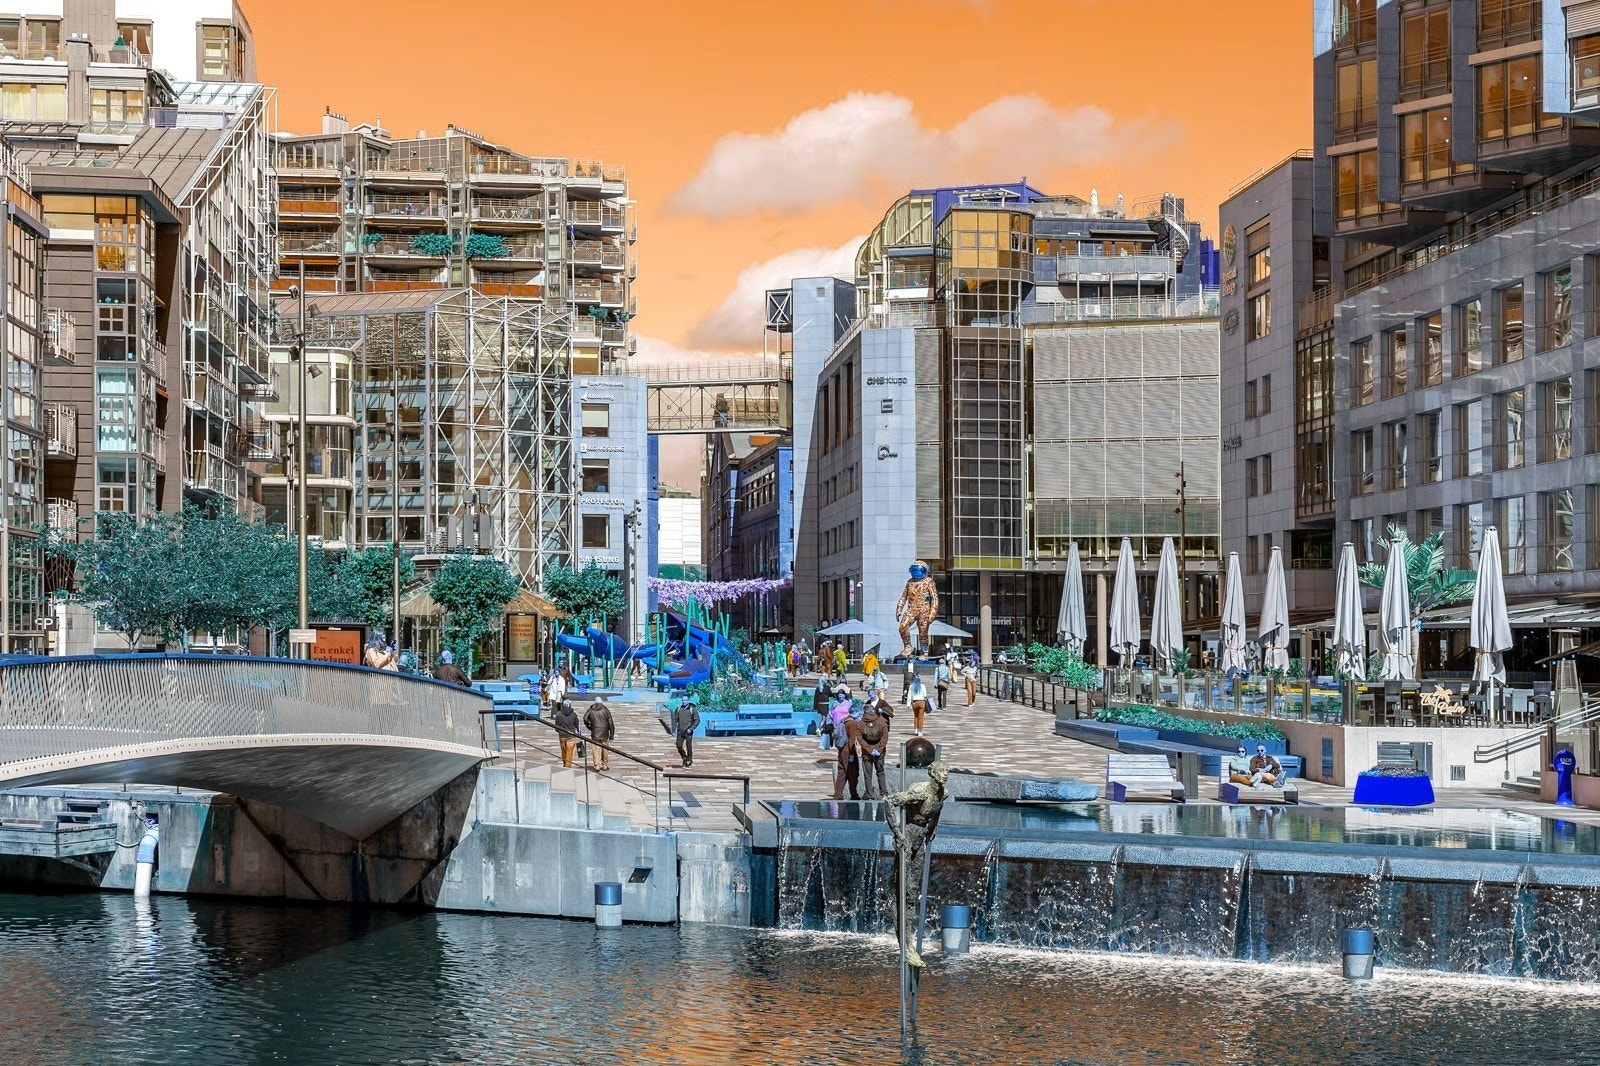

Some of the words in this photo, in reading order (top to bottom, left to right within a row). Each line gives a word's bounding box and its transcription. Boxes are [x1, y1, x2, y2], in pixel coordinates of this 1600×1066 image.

[580, 497, 625, 506] PROTECTOR
[313, 646, 326, 654] En
[328, 646, 354, 654] enkel
[1420, 692, 1437, 706] The
[1438, 701, 1467, 715] Palm
